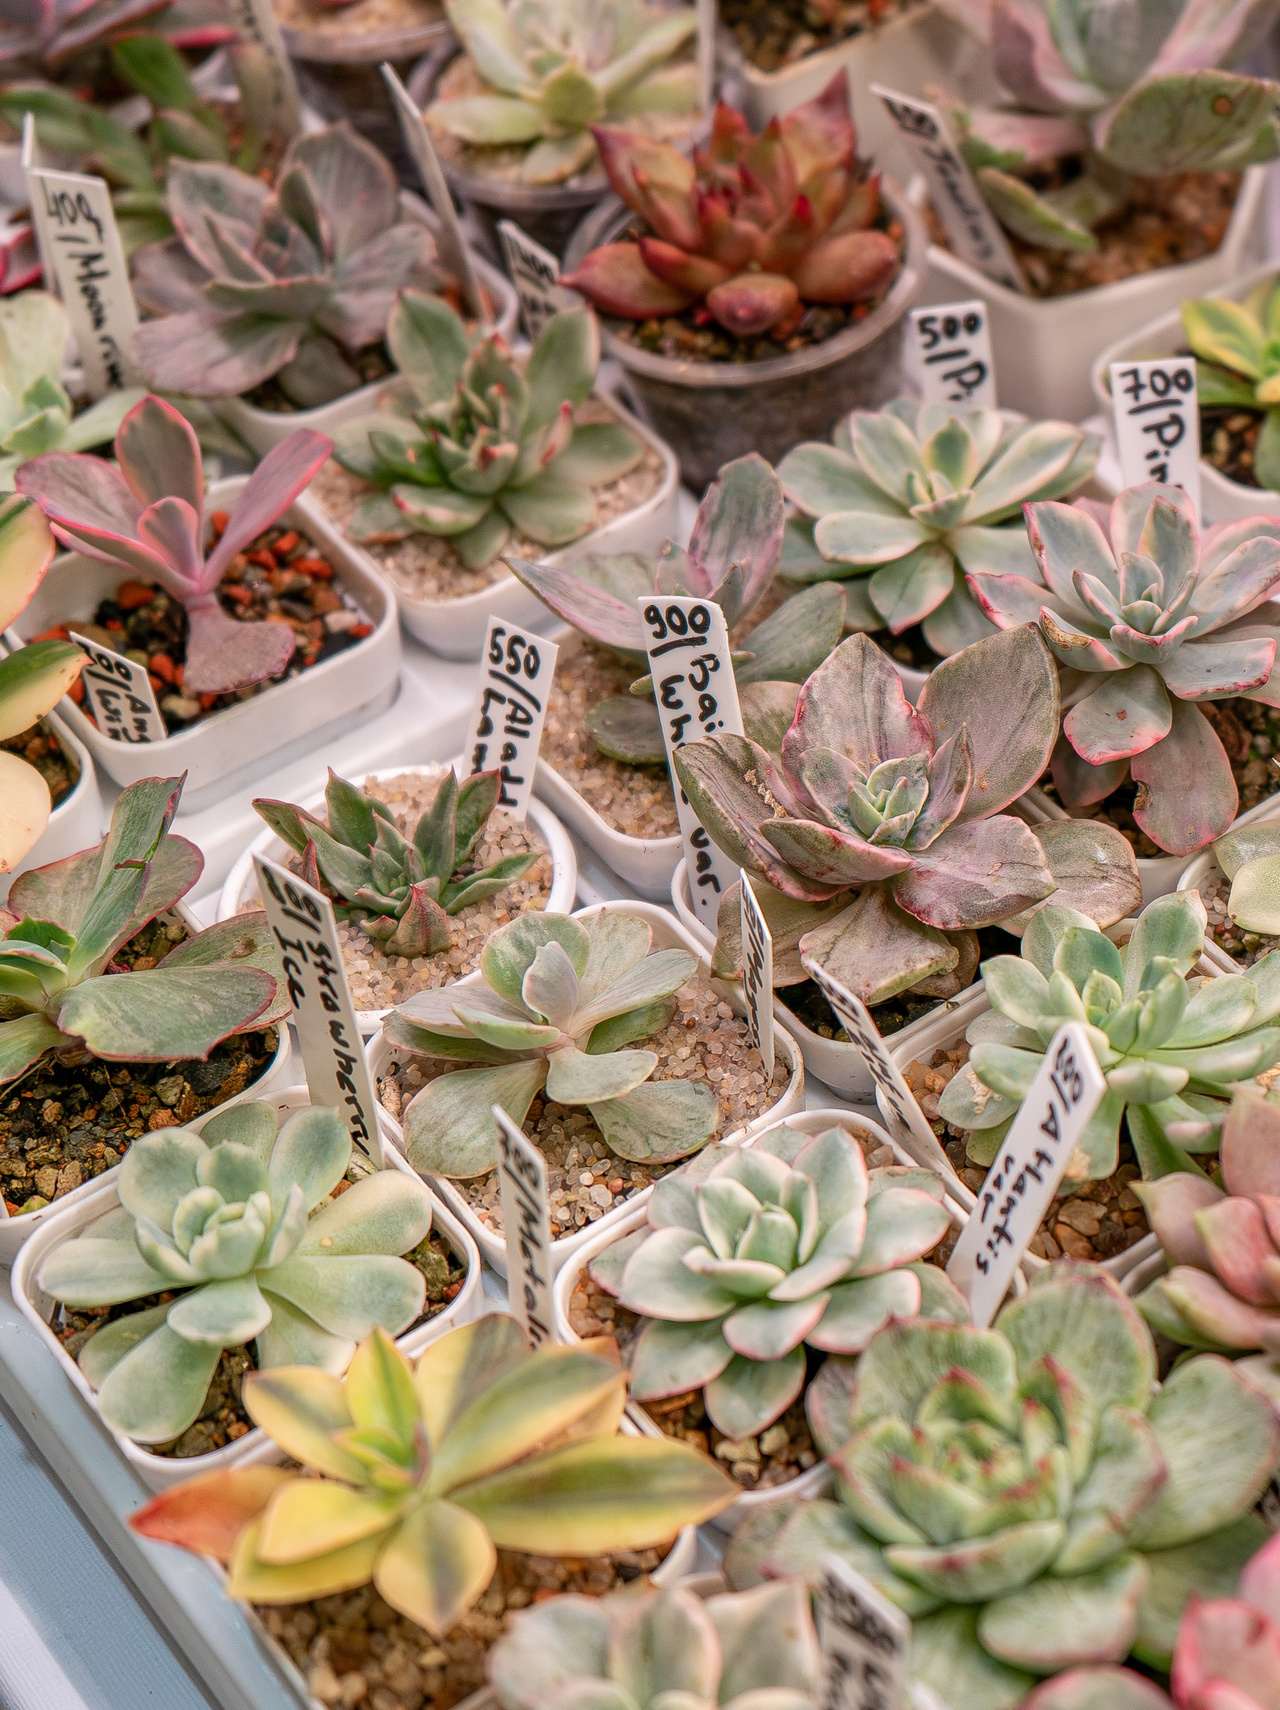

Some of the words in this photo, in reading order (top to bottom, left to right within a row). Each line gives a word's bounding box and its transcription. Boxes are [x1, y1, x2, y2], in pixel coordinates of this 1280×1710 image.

[918, 312, 982, 349] 500
[1119, 367, 1194, 402] 700
[644, 604, 711, 639] 900
[488, 626, 541, 680] 550
[272, 924, 309, 1010] Ice
[305, 939, 371, 1158] Strawberry
